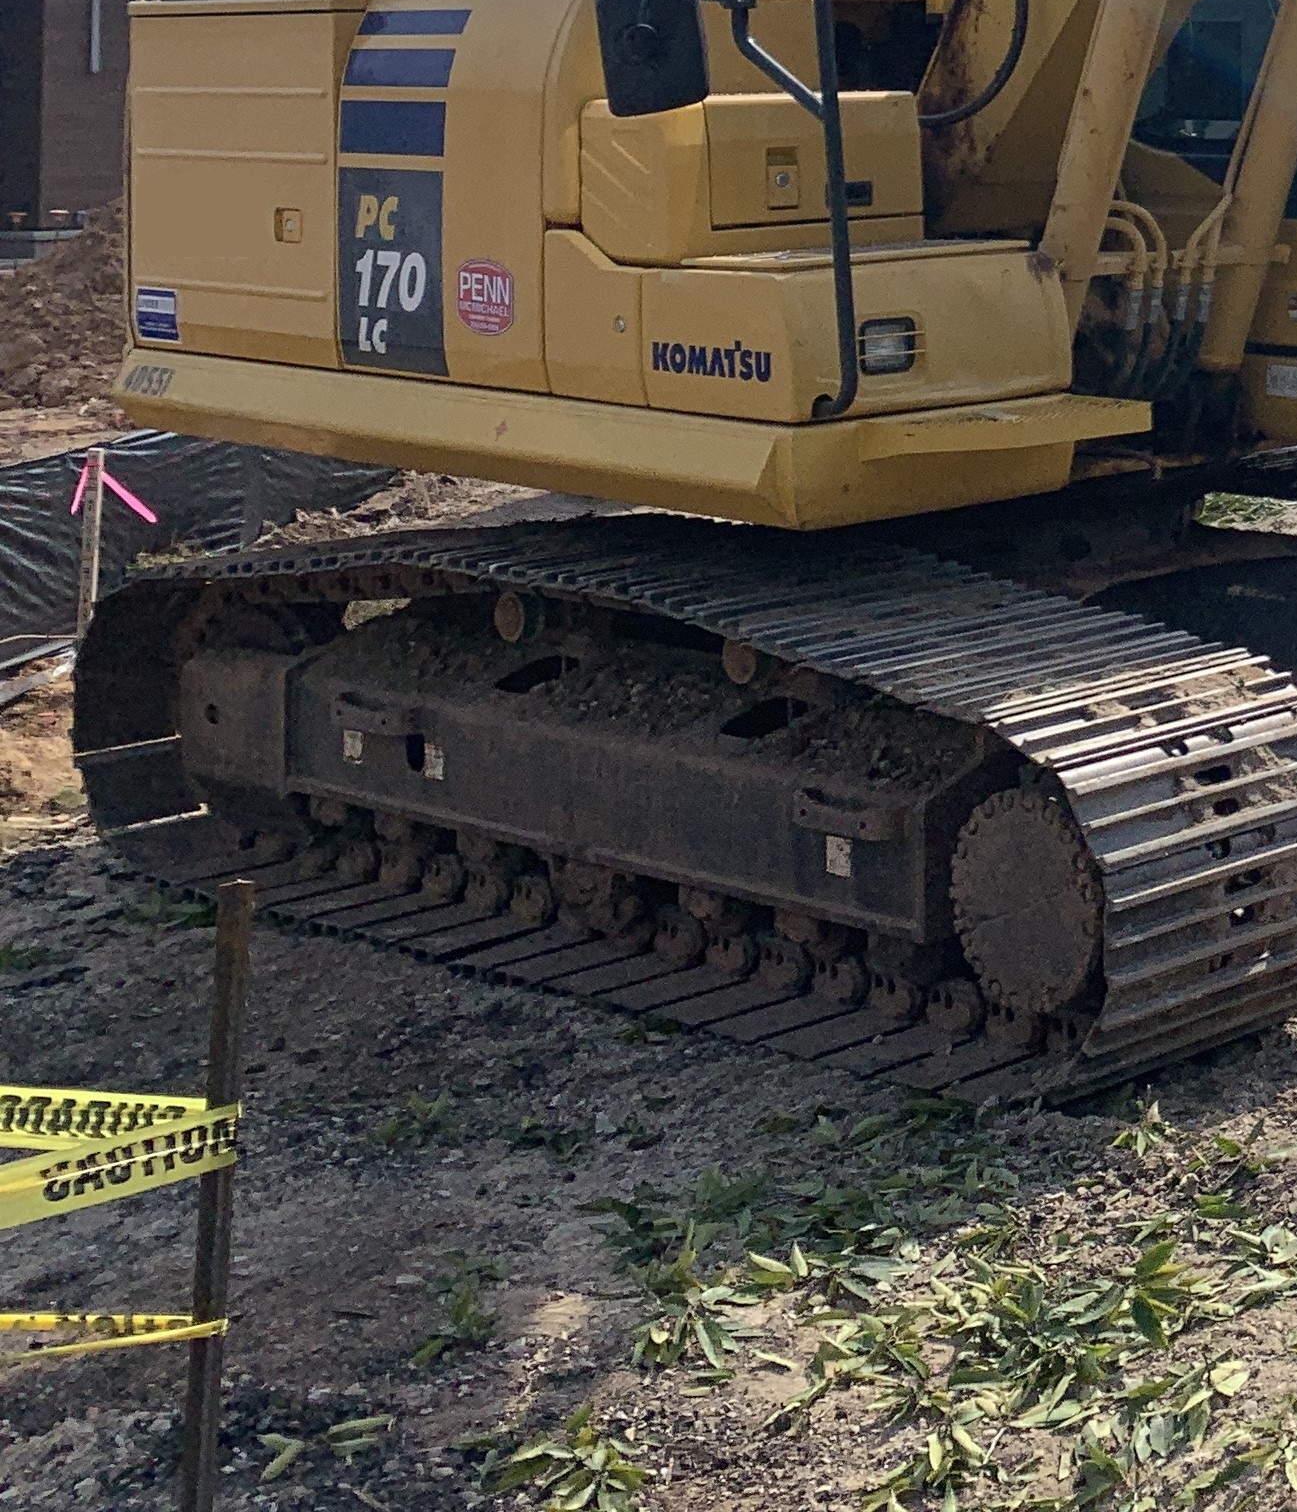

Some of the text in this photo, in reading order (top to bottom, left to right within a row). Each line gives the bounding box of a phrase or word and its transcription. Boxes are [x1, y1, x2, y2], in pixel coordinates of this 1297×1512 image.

[354, 193, 399, 241] PC
[354, 248, 427, 313] 170
[459, 271, 510, 306] PENN
[357, 316, 389, 355] LC
[651, 339, 772, 383] KOMATSU
